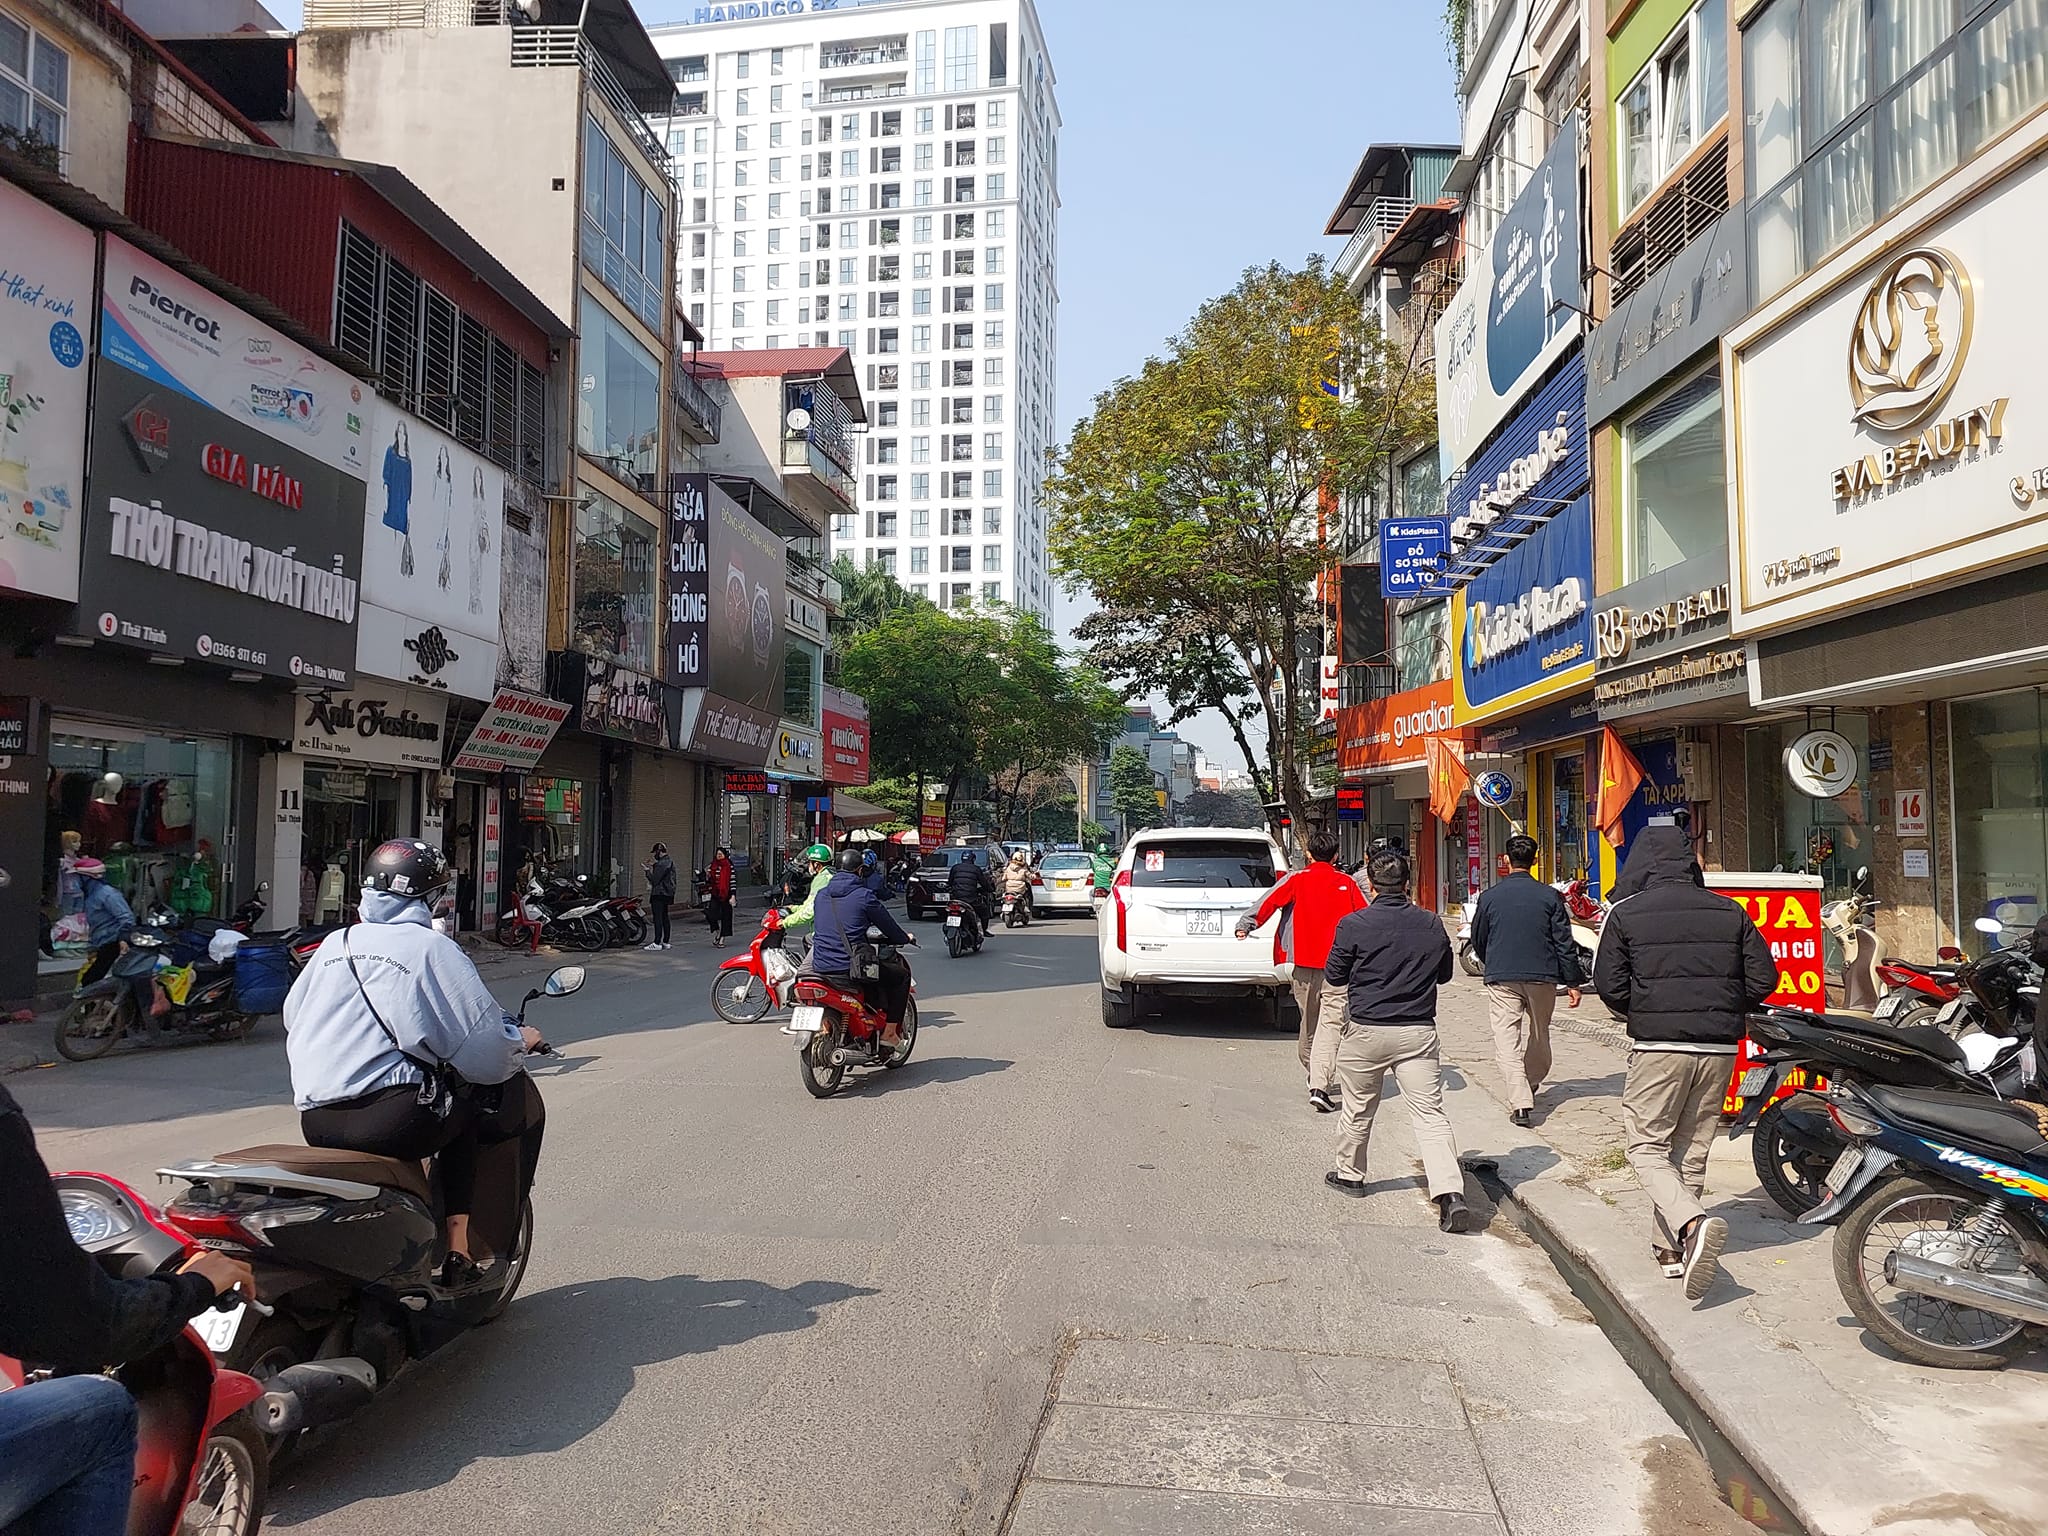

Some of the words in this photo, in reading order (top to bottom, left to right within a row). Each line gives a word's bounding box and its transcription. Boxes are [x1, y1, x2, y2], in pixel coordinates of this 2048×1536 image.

[694, 0, 804, 24] HANDICO
[129, 275, 221, 341] Pierrot
[250, 383, 282, 398] Pierrot
[1537, 409, 1569, 479] bé
[1831, 456, 1880, 501] EVA
[1881, 398, 2008, 479] BEAUTY
[202, 443, 248, 488] GIA
[1400, 527, 1440, 536] KidsPlaza
[174, 519, 252, 594] TRANG
[251, 546, 306, 610] XUẤT
[302, 553, 357, 625] KHẨU
[1412, 557, 1438, 567] SINH
[1772, 560, 1787, 580] 16
[1788, 554, 1808, 575] THÁI
[1810, 547, 1838, 569] THỊNH
[1390, 569, 1415, 585] GIÁ
[671, 581, 707, 623] ĐỒNG
[105, 615, 113, 632] 9
[120, 621, 142, 638] Thái
[142, 626, 168, 646] Thịnh
[1468, 577, 1581, 665] KidsPlaza
[1594, 606, 1626, 660] RB
[1631, 603, 1673, 641] ROSY
[212, 641, 235, 657] 0366
[678, 632, 699, 674] HỒ
[1713, 652, 1735, 672] CAO
[356, 700, 440, 742] Fashion
[702, 704, 725, 738] THẾ
[720, 712, 738, 741] GIỚI
[736, 713, 759, 748] ĐỒNG
[757, 720, 774, 750] HỒ
[475, 728, 494, 741] TIVI
[279, 789, 299, 810] 11
[508, 787, 517, 801] 13
[1902, 795, 1921, 818] 16
[1187, 922, 1220, 933] 372.04
[1194, 910, 1212, 921] 30F
[1791, 939, 1816, 959] CŨ
[384, 956, 412, 976] bonne
[1937, 1146, 2028, 1180] Wave
